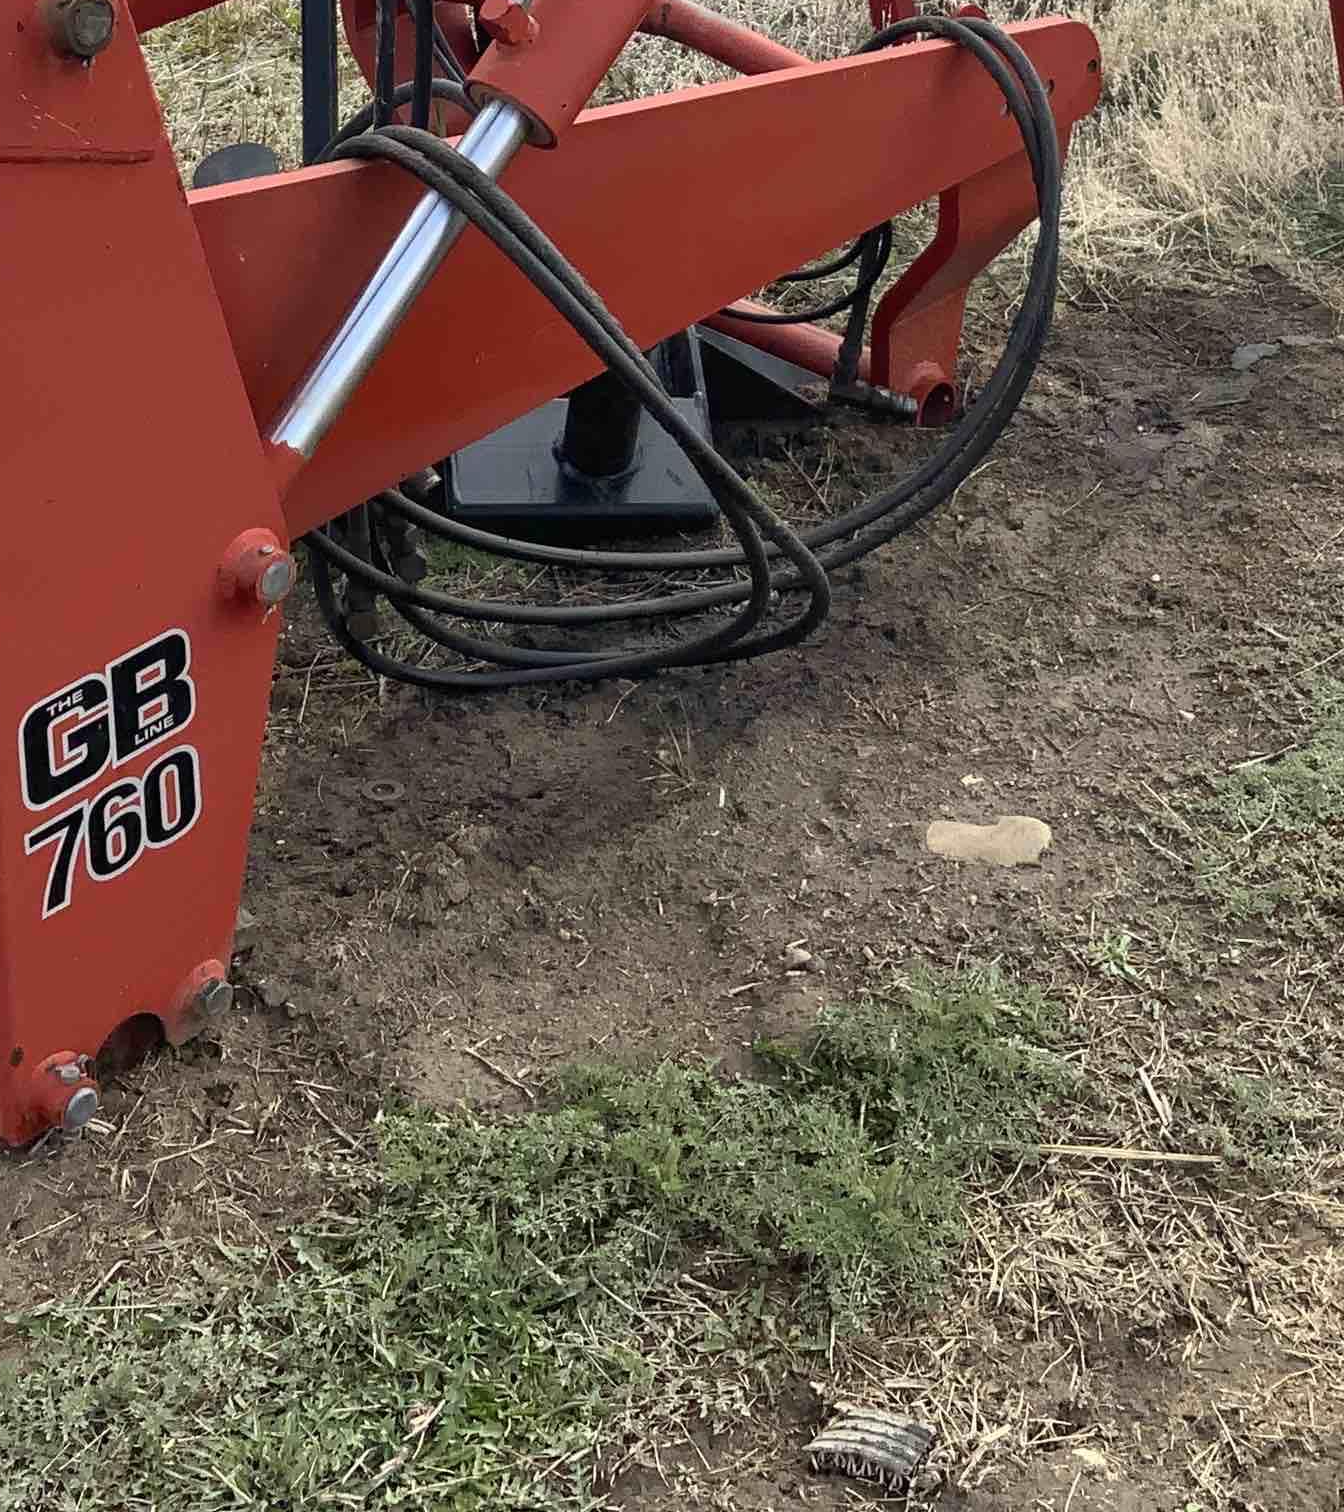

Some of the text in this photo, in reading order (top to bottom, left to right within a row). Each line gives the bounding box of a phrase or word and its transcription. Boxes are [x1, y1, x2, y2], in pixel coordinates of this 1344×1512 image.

[18, 628, 195, 811] GB
[47, 689, 85, 717] THE
[135, 715, 175, 745] LINE
[24, 744, 202, 920] 760
